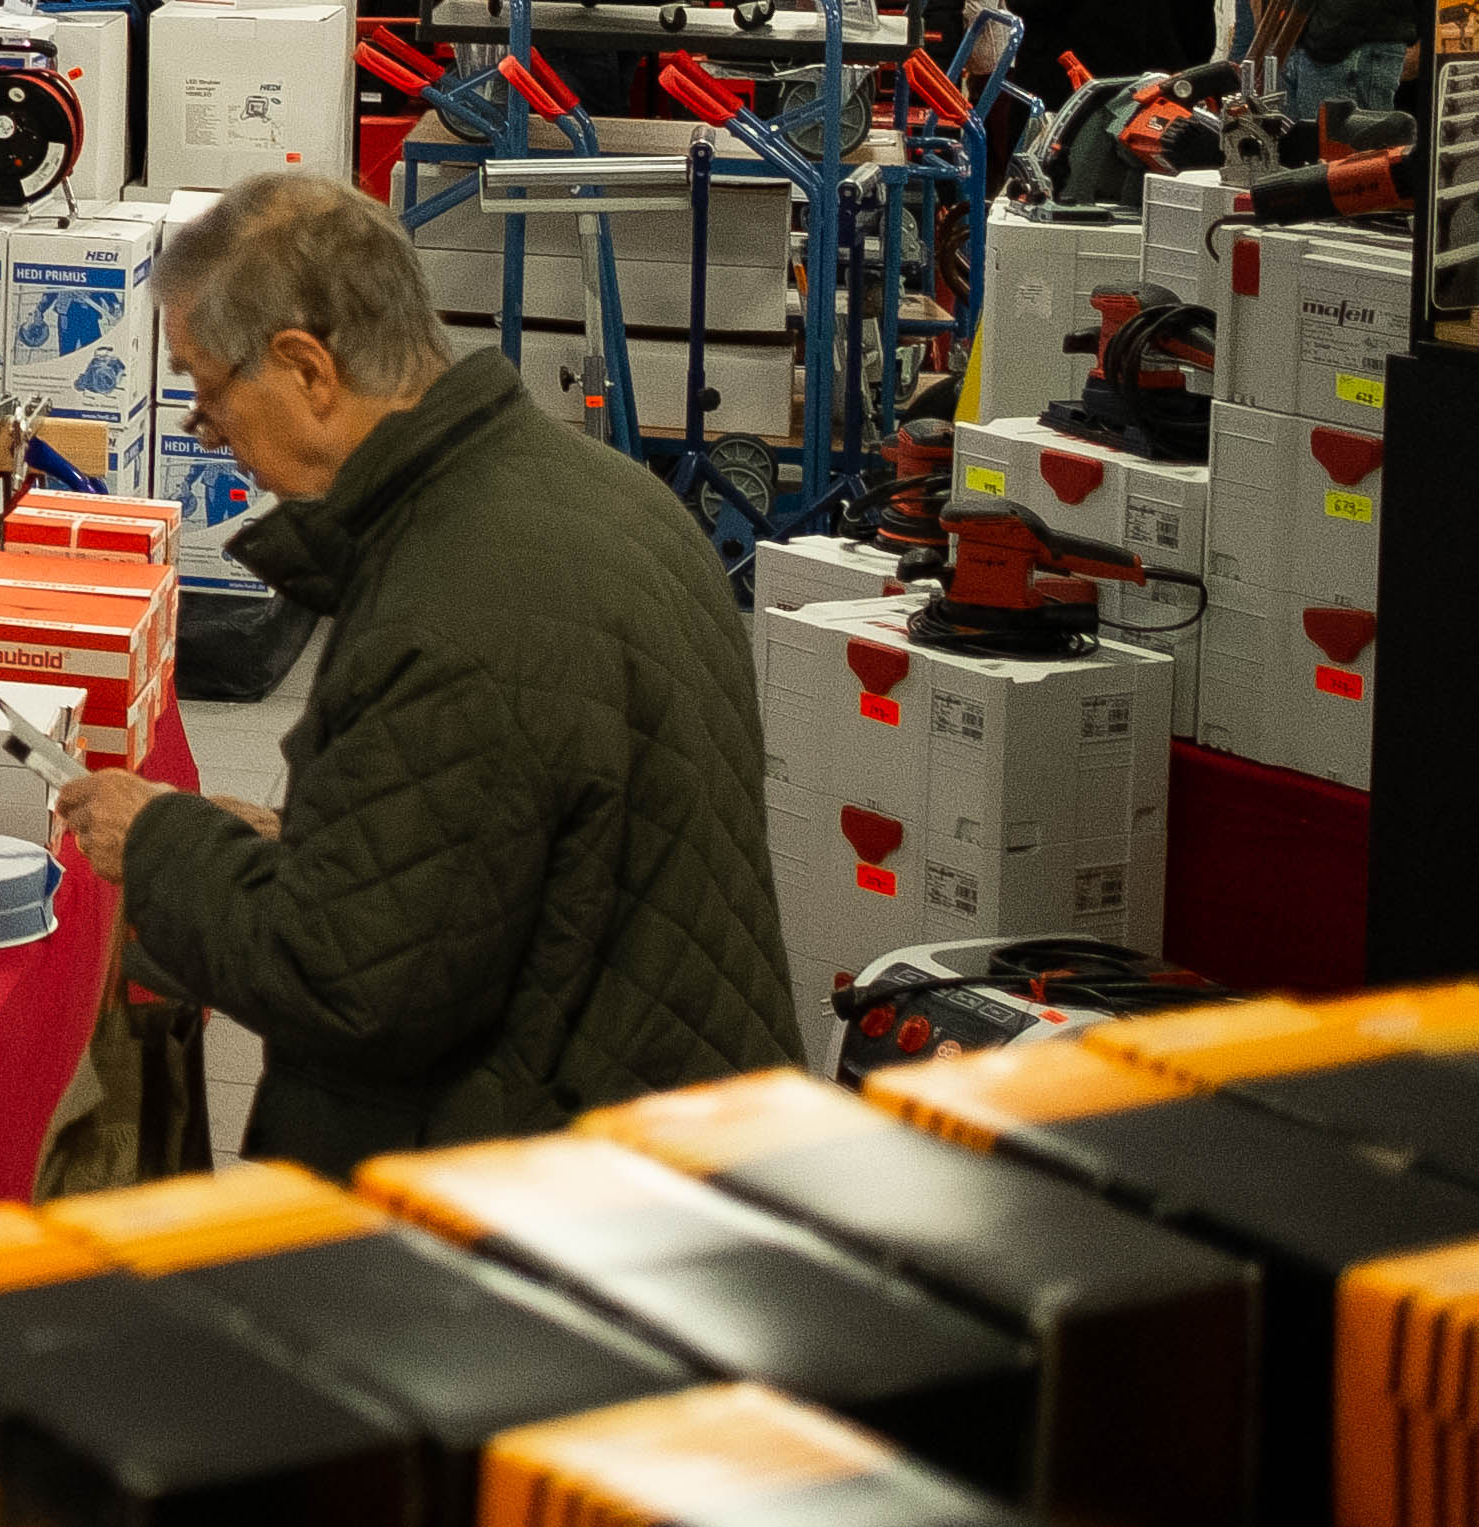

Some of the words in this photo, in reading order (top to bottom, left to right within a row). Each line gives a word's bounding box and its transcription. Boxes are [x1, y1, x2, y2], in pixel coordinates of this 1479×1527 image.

[85, 250, 119, 263] HEDI
[16, 267, 43, 281] HEDI
[45, 269, 88, 284] PRIMUS
[1302, 299, 1375, 326] mafell
[164, 440, 191, 452] HEDI
